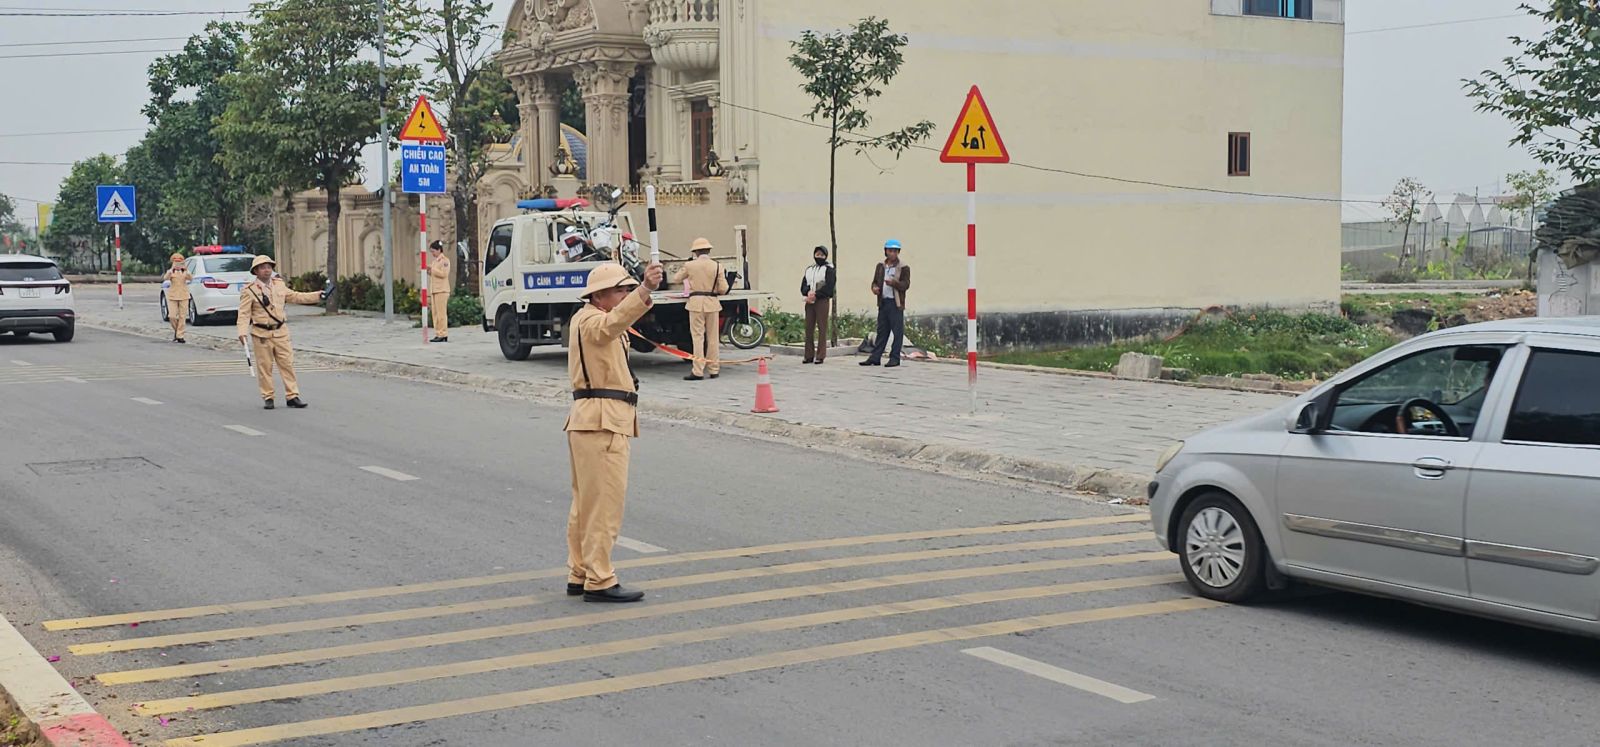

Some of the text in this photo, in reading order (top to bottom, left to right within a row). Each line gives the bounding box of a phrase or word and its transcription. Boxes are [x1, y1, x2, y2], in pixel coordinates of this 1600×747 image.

[428, 150, 444, 161] CAO
[409, 163, 419, 174] AN
[418, 177, 430, 187] 5M
